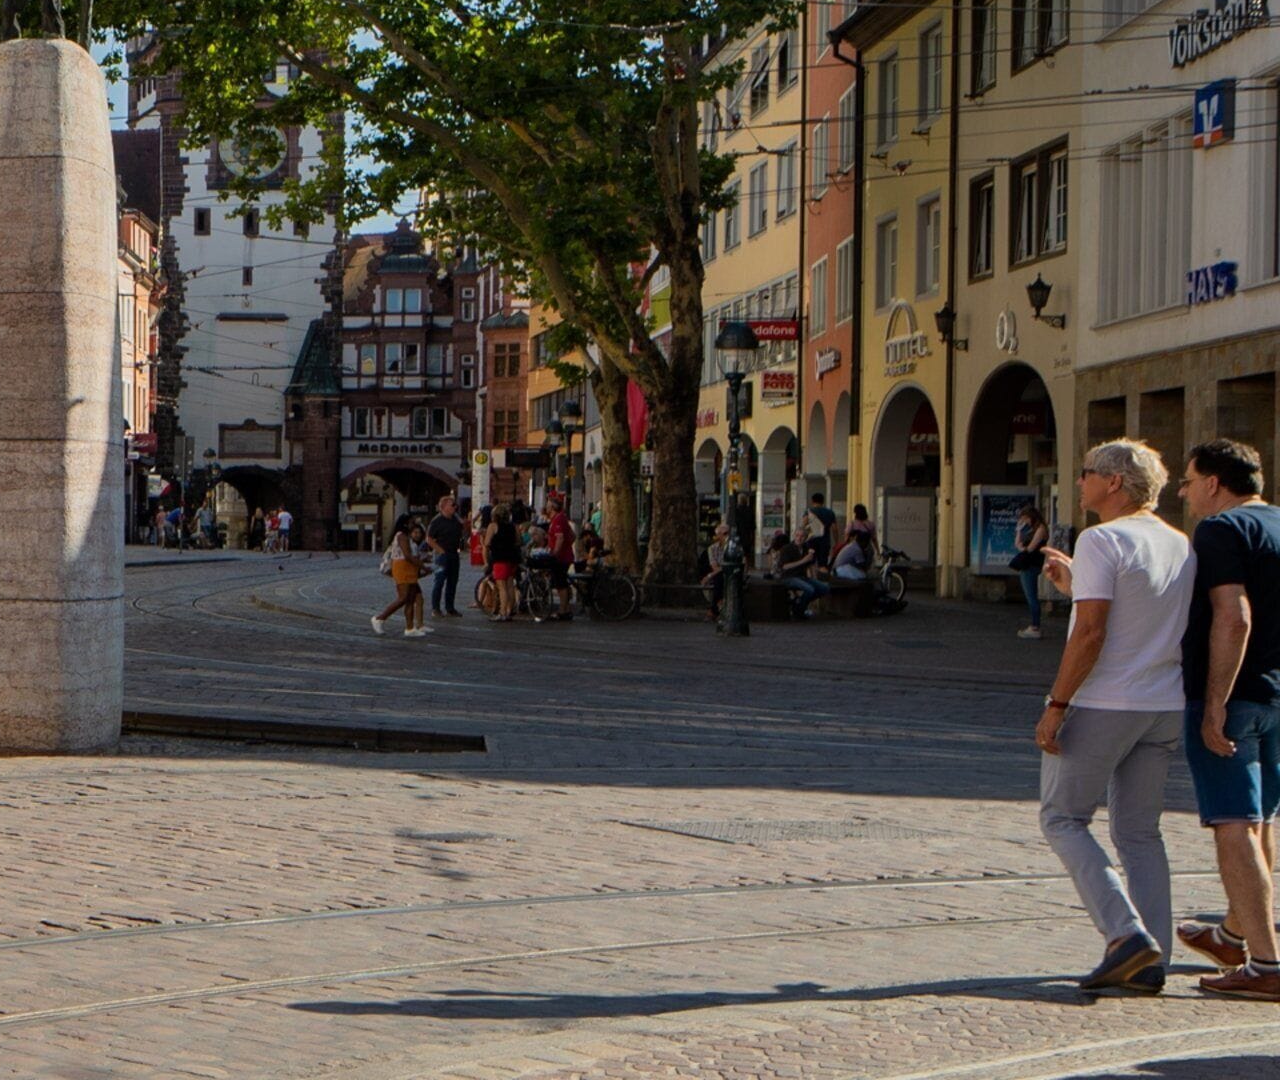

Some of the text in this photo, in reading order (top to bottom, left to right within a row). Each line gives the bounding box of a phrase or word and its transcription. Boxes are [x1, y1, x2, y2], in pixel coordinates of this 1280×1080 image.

[1186, 262, 1236, 306] HAYS
[752, 325, 796, 336] dafone
[764, 372, 794, 381] PASS
[763, 380, 795, 390] FOTO
[357, 443, 444, 454] McDonald's
